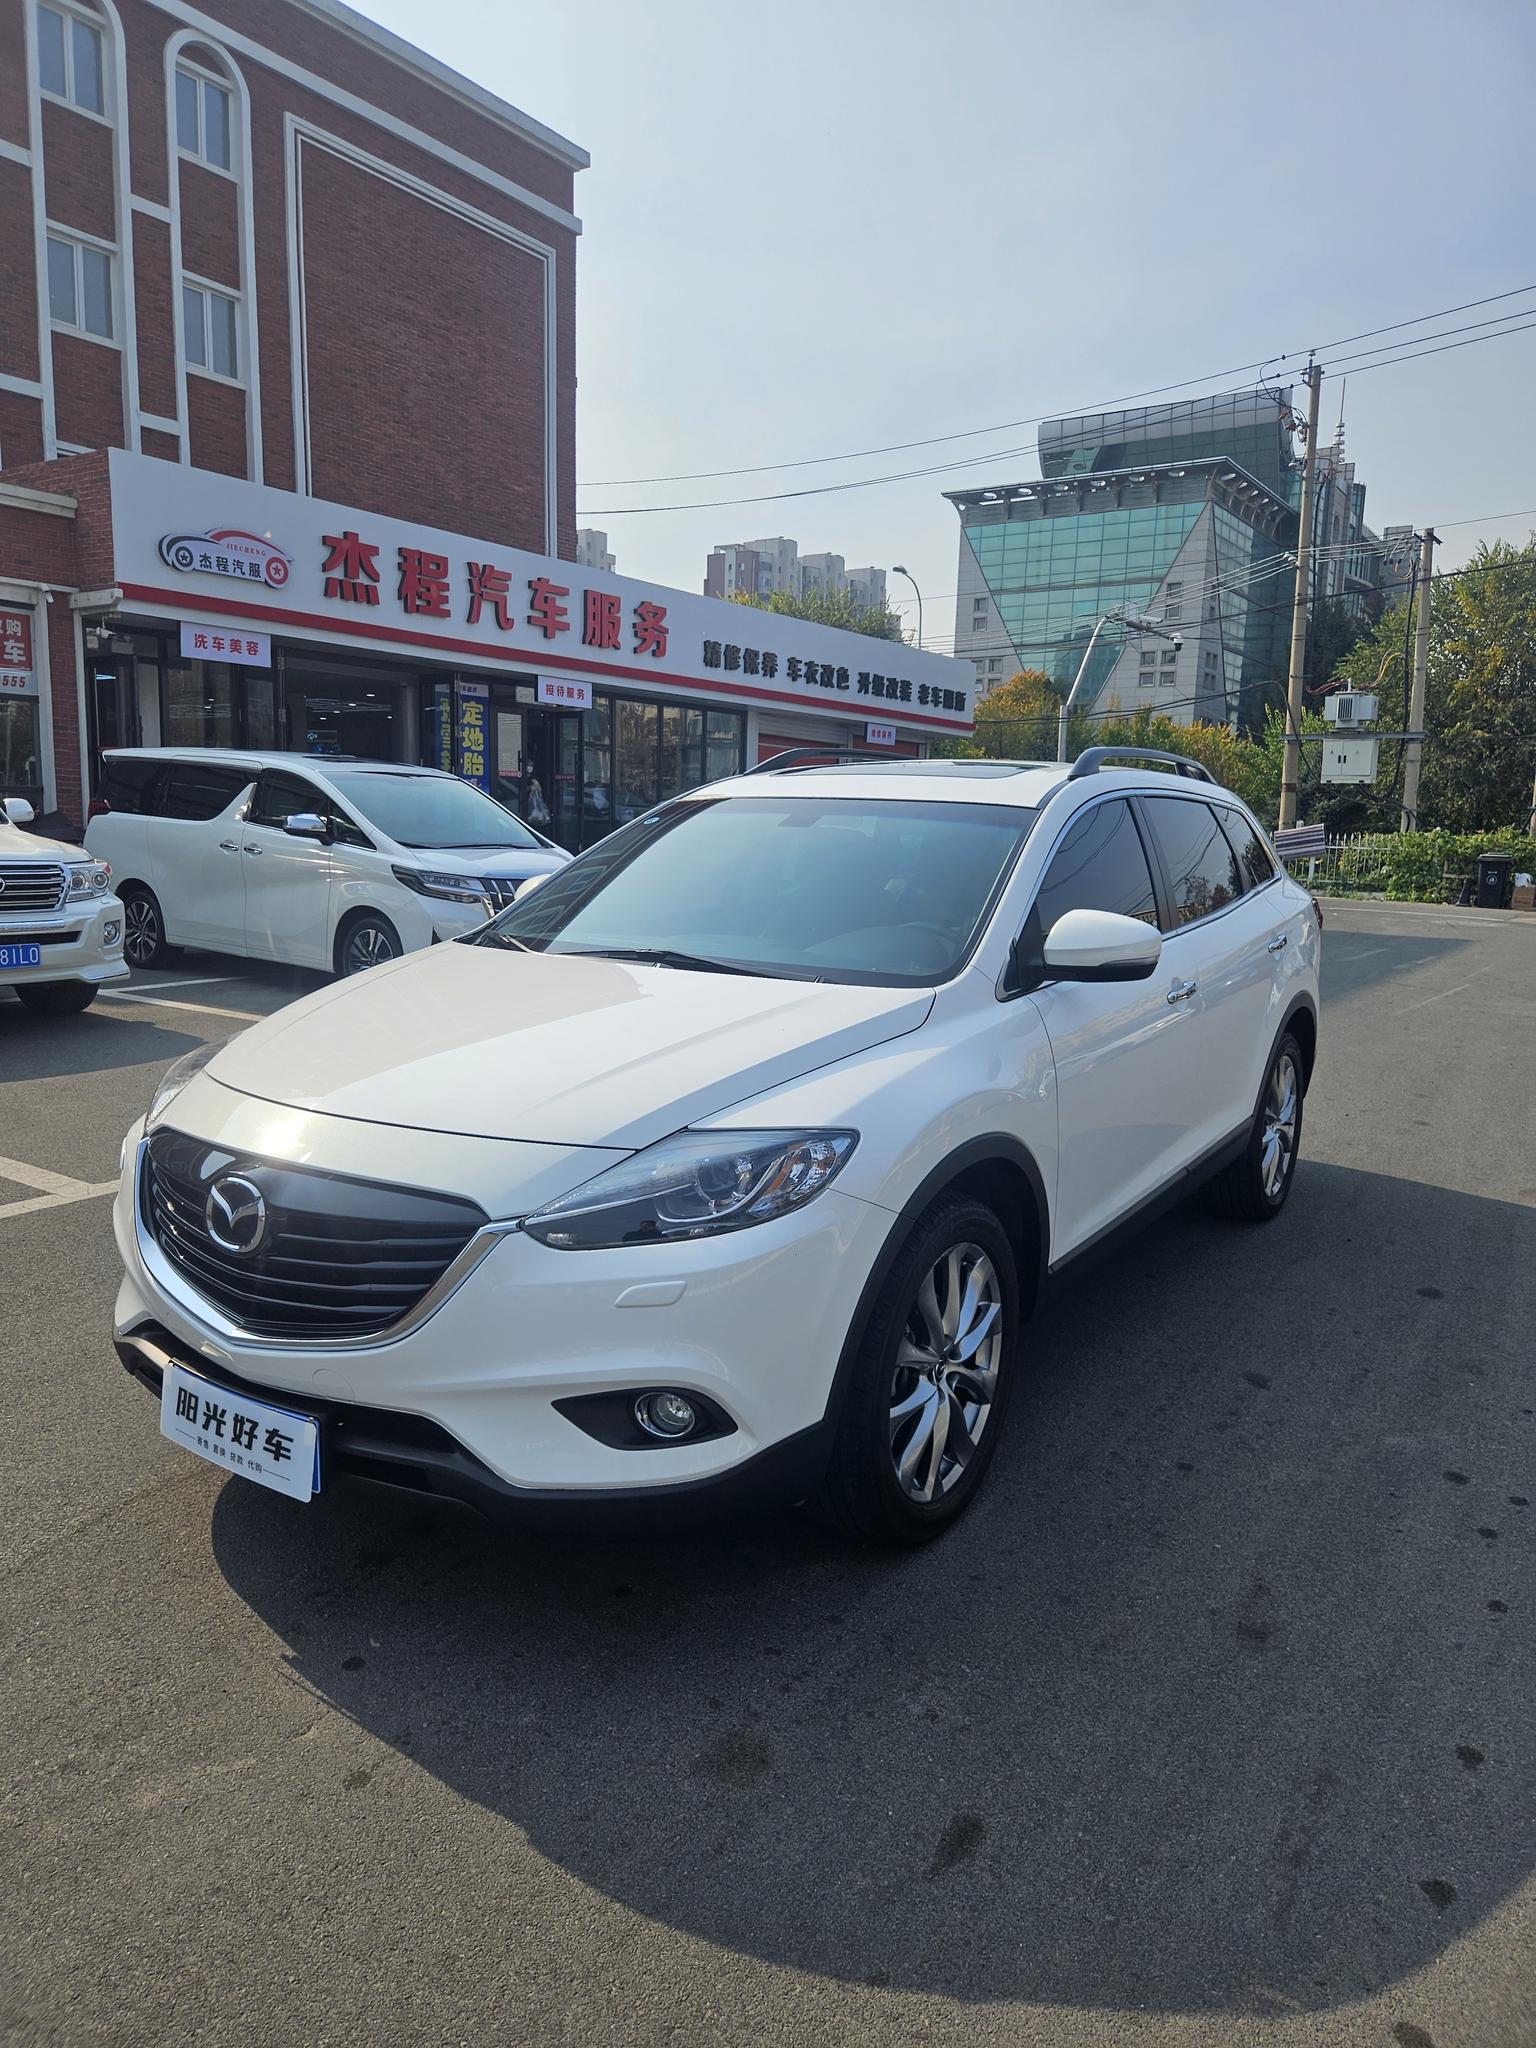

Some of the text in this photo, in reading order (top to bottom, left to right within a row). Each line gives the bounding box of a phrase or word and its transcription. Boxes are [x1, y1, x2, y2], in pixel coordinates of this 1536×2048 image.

[226, 543, 266, 556] JIECHENG
[199, 553, 262, 578] 杰程汽服
[321, 531, 670, 657] 杰程汽车服务
[0, 618, 22, 636] 购
[3, 639, 27, 663] 车
[193, 632, 260, 656] 洗车美容
[2, 675, 26, 688] 555
[703, 640, 778, 678] 精修保养
[787, 656, 850, 690] 车衣改色
[857, 671, 912, 703] 升级改装
[545, 683, 585, 700] 接待服务
[462, 700, 485, 776] 定地胎
[175, 1386, 294, 1462] 阳光好车
[247, 1460, 263, 1474] 代购
